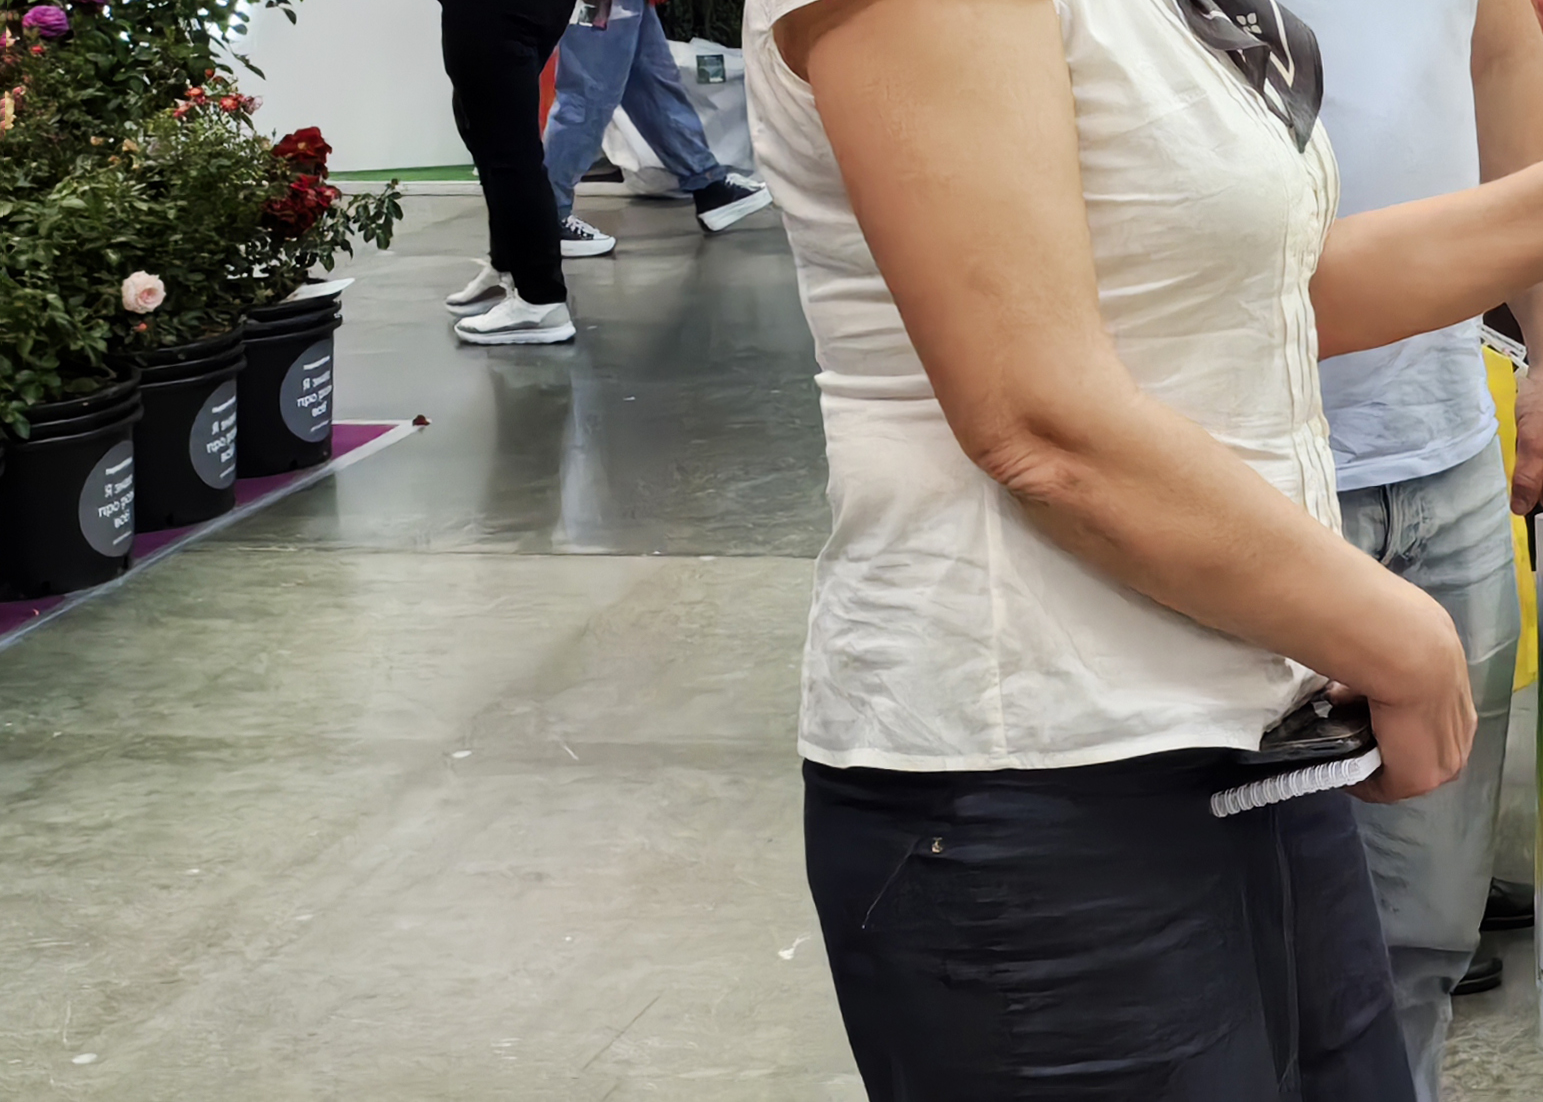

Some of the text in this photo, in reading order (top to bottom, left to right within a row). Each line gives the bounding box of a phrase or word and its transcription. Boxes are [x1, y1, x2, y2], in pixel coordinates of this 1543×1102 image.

[297, 392, 318, 407] про
[206, 436, 227, 454] про
[98, 500, 120, 517] про
